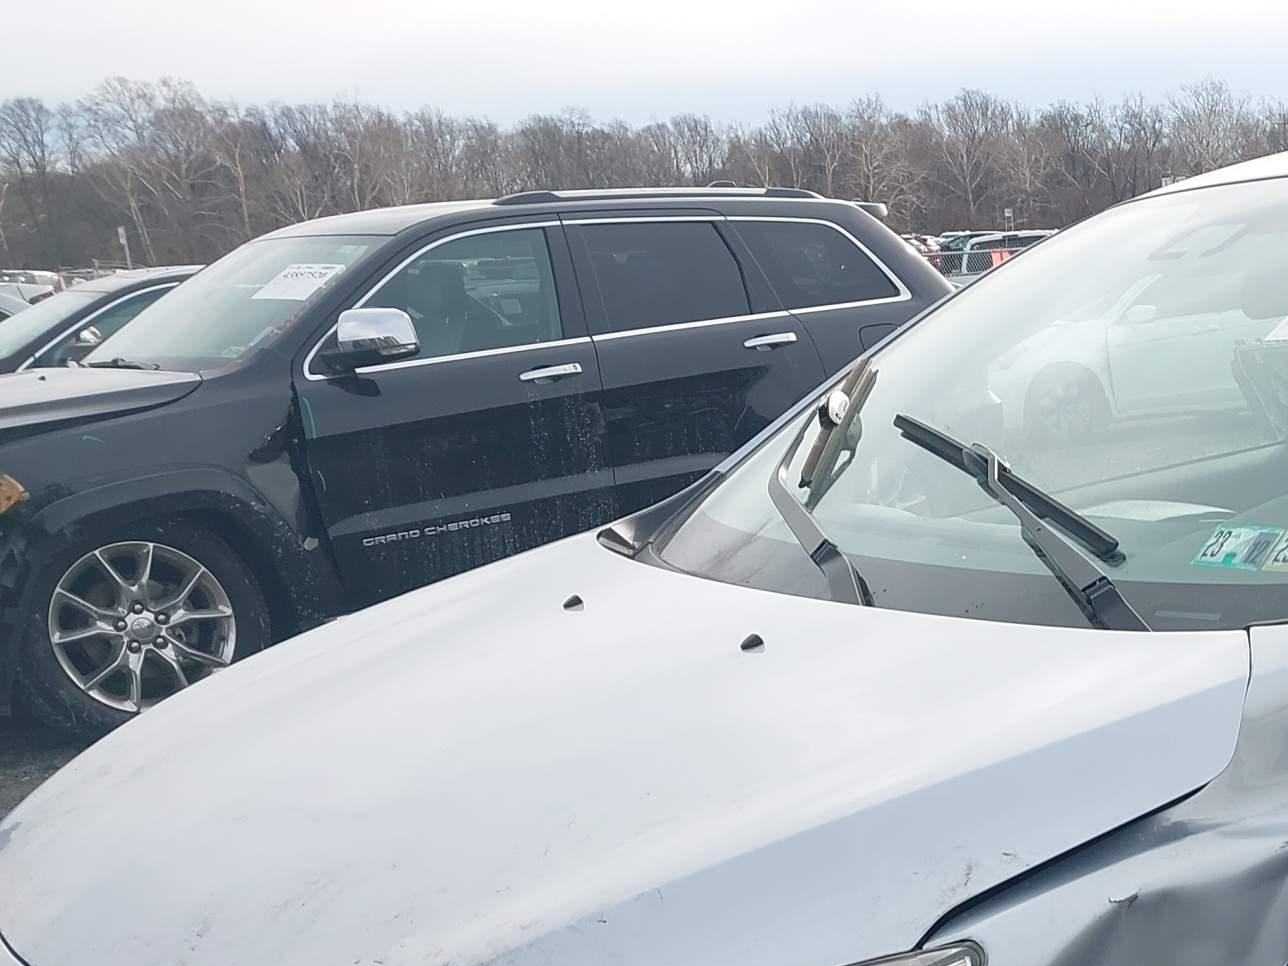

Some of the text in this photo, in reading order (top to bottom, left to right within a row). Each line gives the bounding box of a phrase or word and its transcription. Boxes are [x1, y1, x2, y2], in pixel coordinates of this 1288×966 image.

[362, 512, 512, 547] GRAND CHEROKEE
[1202, 530, 1232, 558] 23
